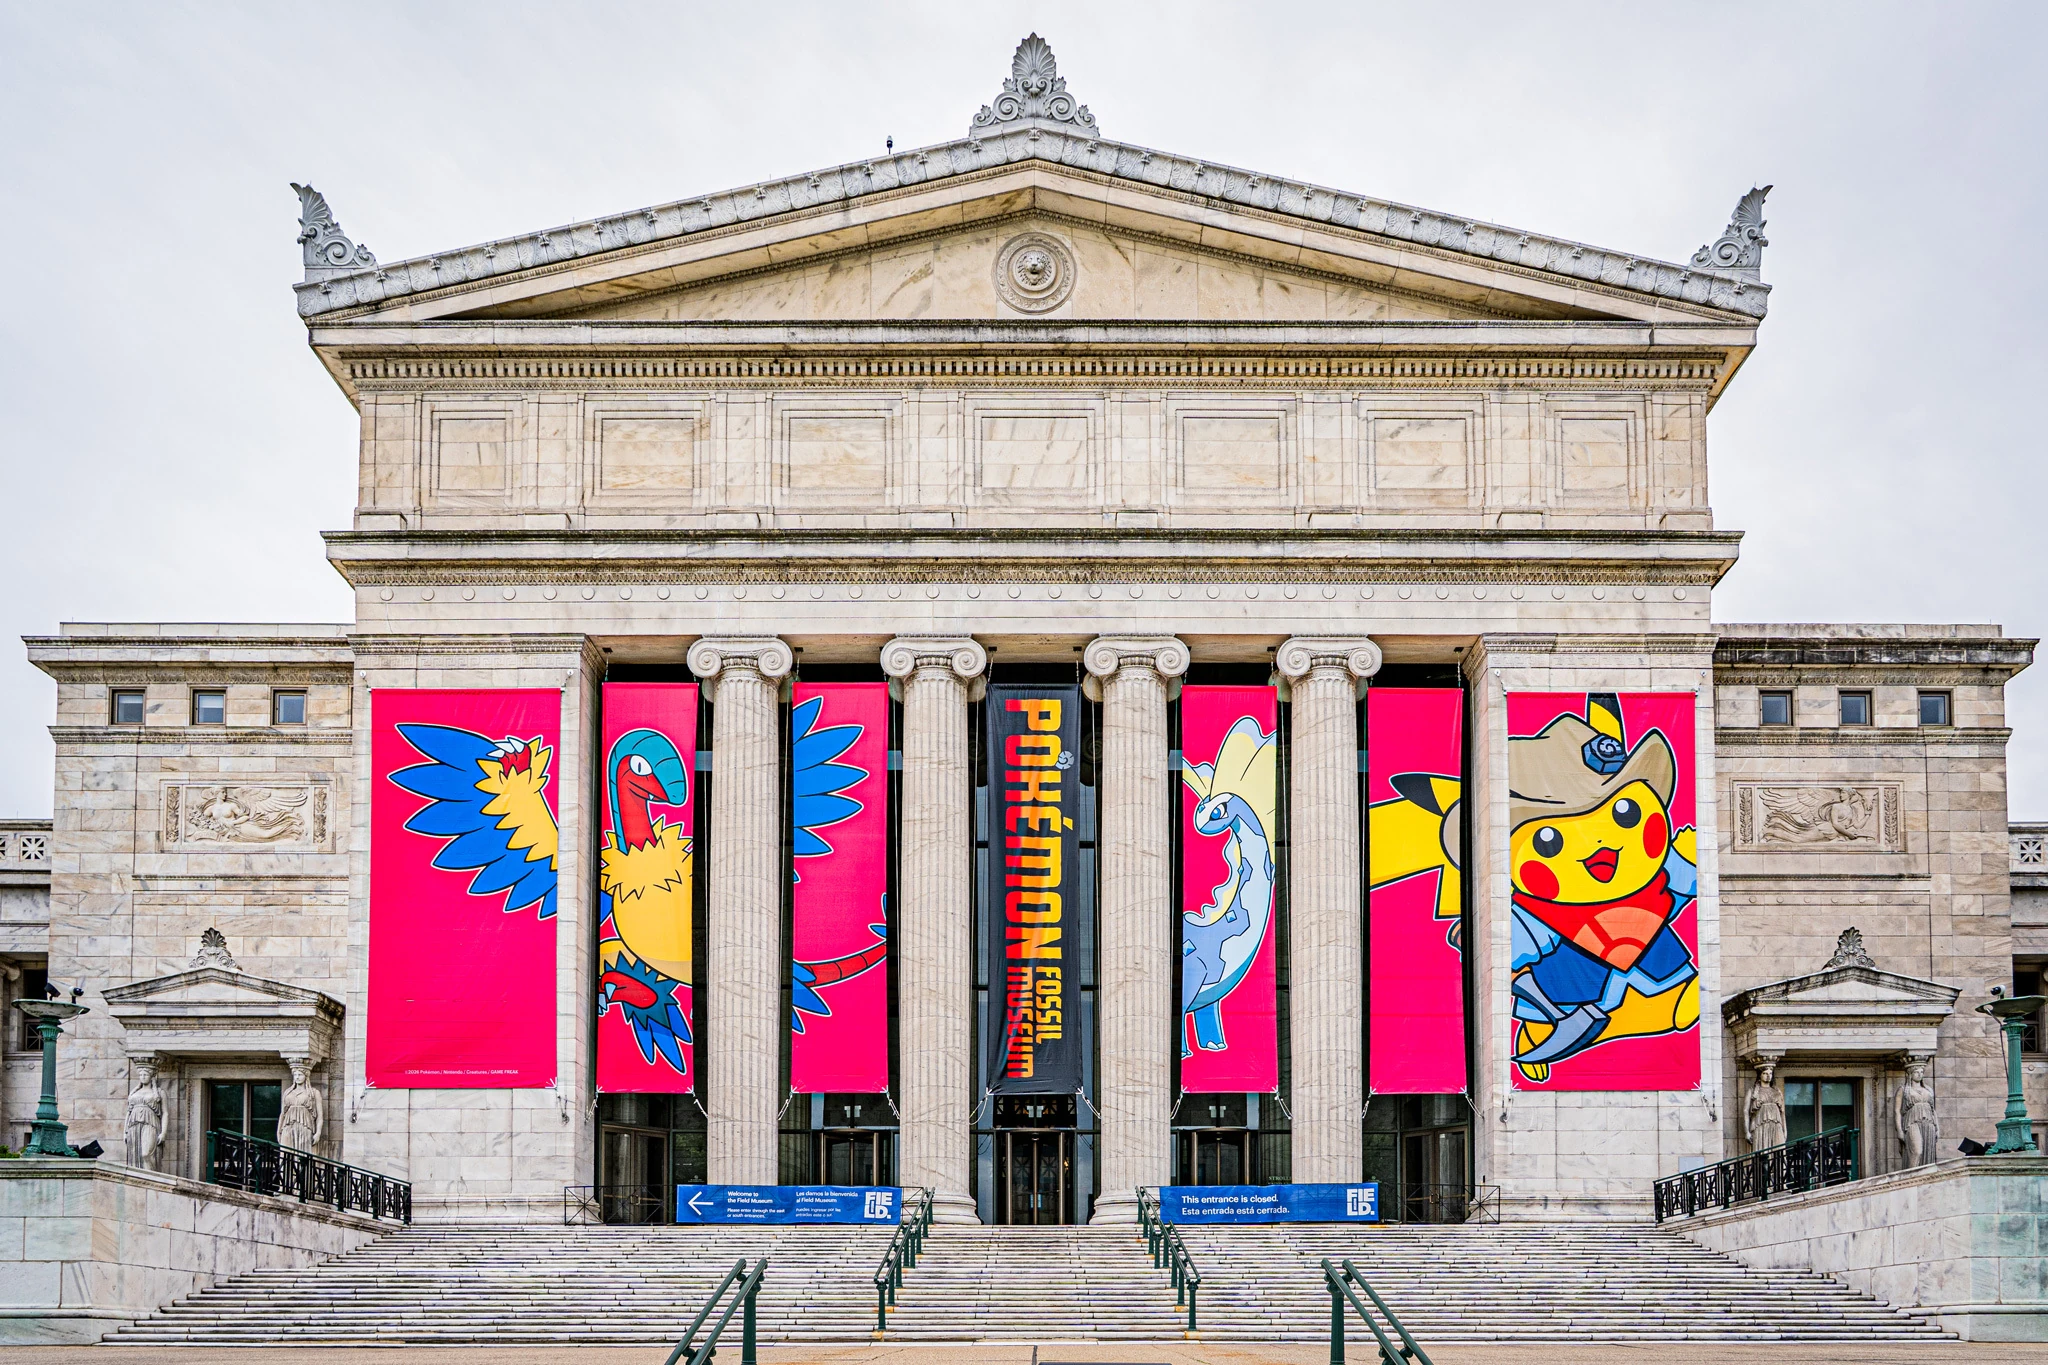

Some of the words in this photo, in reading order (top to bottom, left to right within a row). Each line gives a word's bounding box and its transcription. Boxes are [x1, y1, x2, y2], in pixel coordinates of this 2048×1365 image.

[1005, 699, 1073, 960] POKÉMON
[1007, 966, 1033, 1078] MUSEUM
[1036, 966, 1062, 1045] FOSSIL
[1181, 1195, 1199, 1204] This
[1201, 1195, 1239, 1204] entrance
[1240, 1194, 1248, 1203] is
[1249, 1193, 1279, 1203] closed.
[1181, 1207, 1200, 1216] Esta
[1201, 1206, 1235, 1215] entrada
[1236, 1206, 1255, 1215] está
[1256, 1205, 1290, 1214] cerrada.
